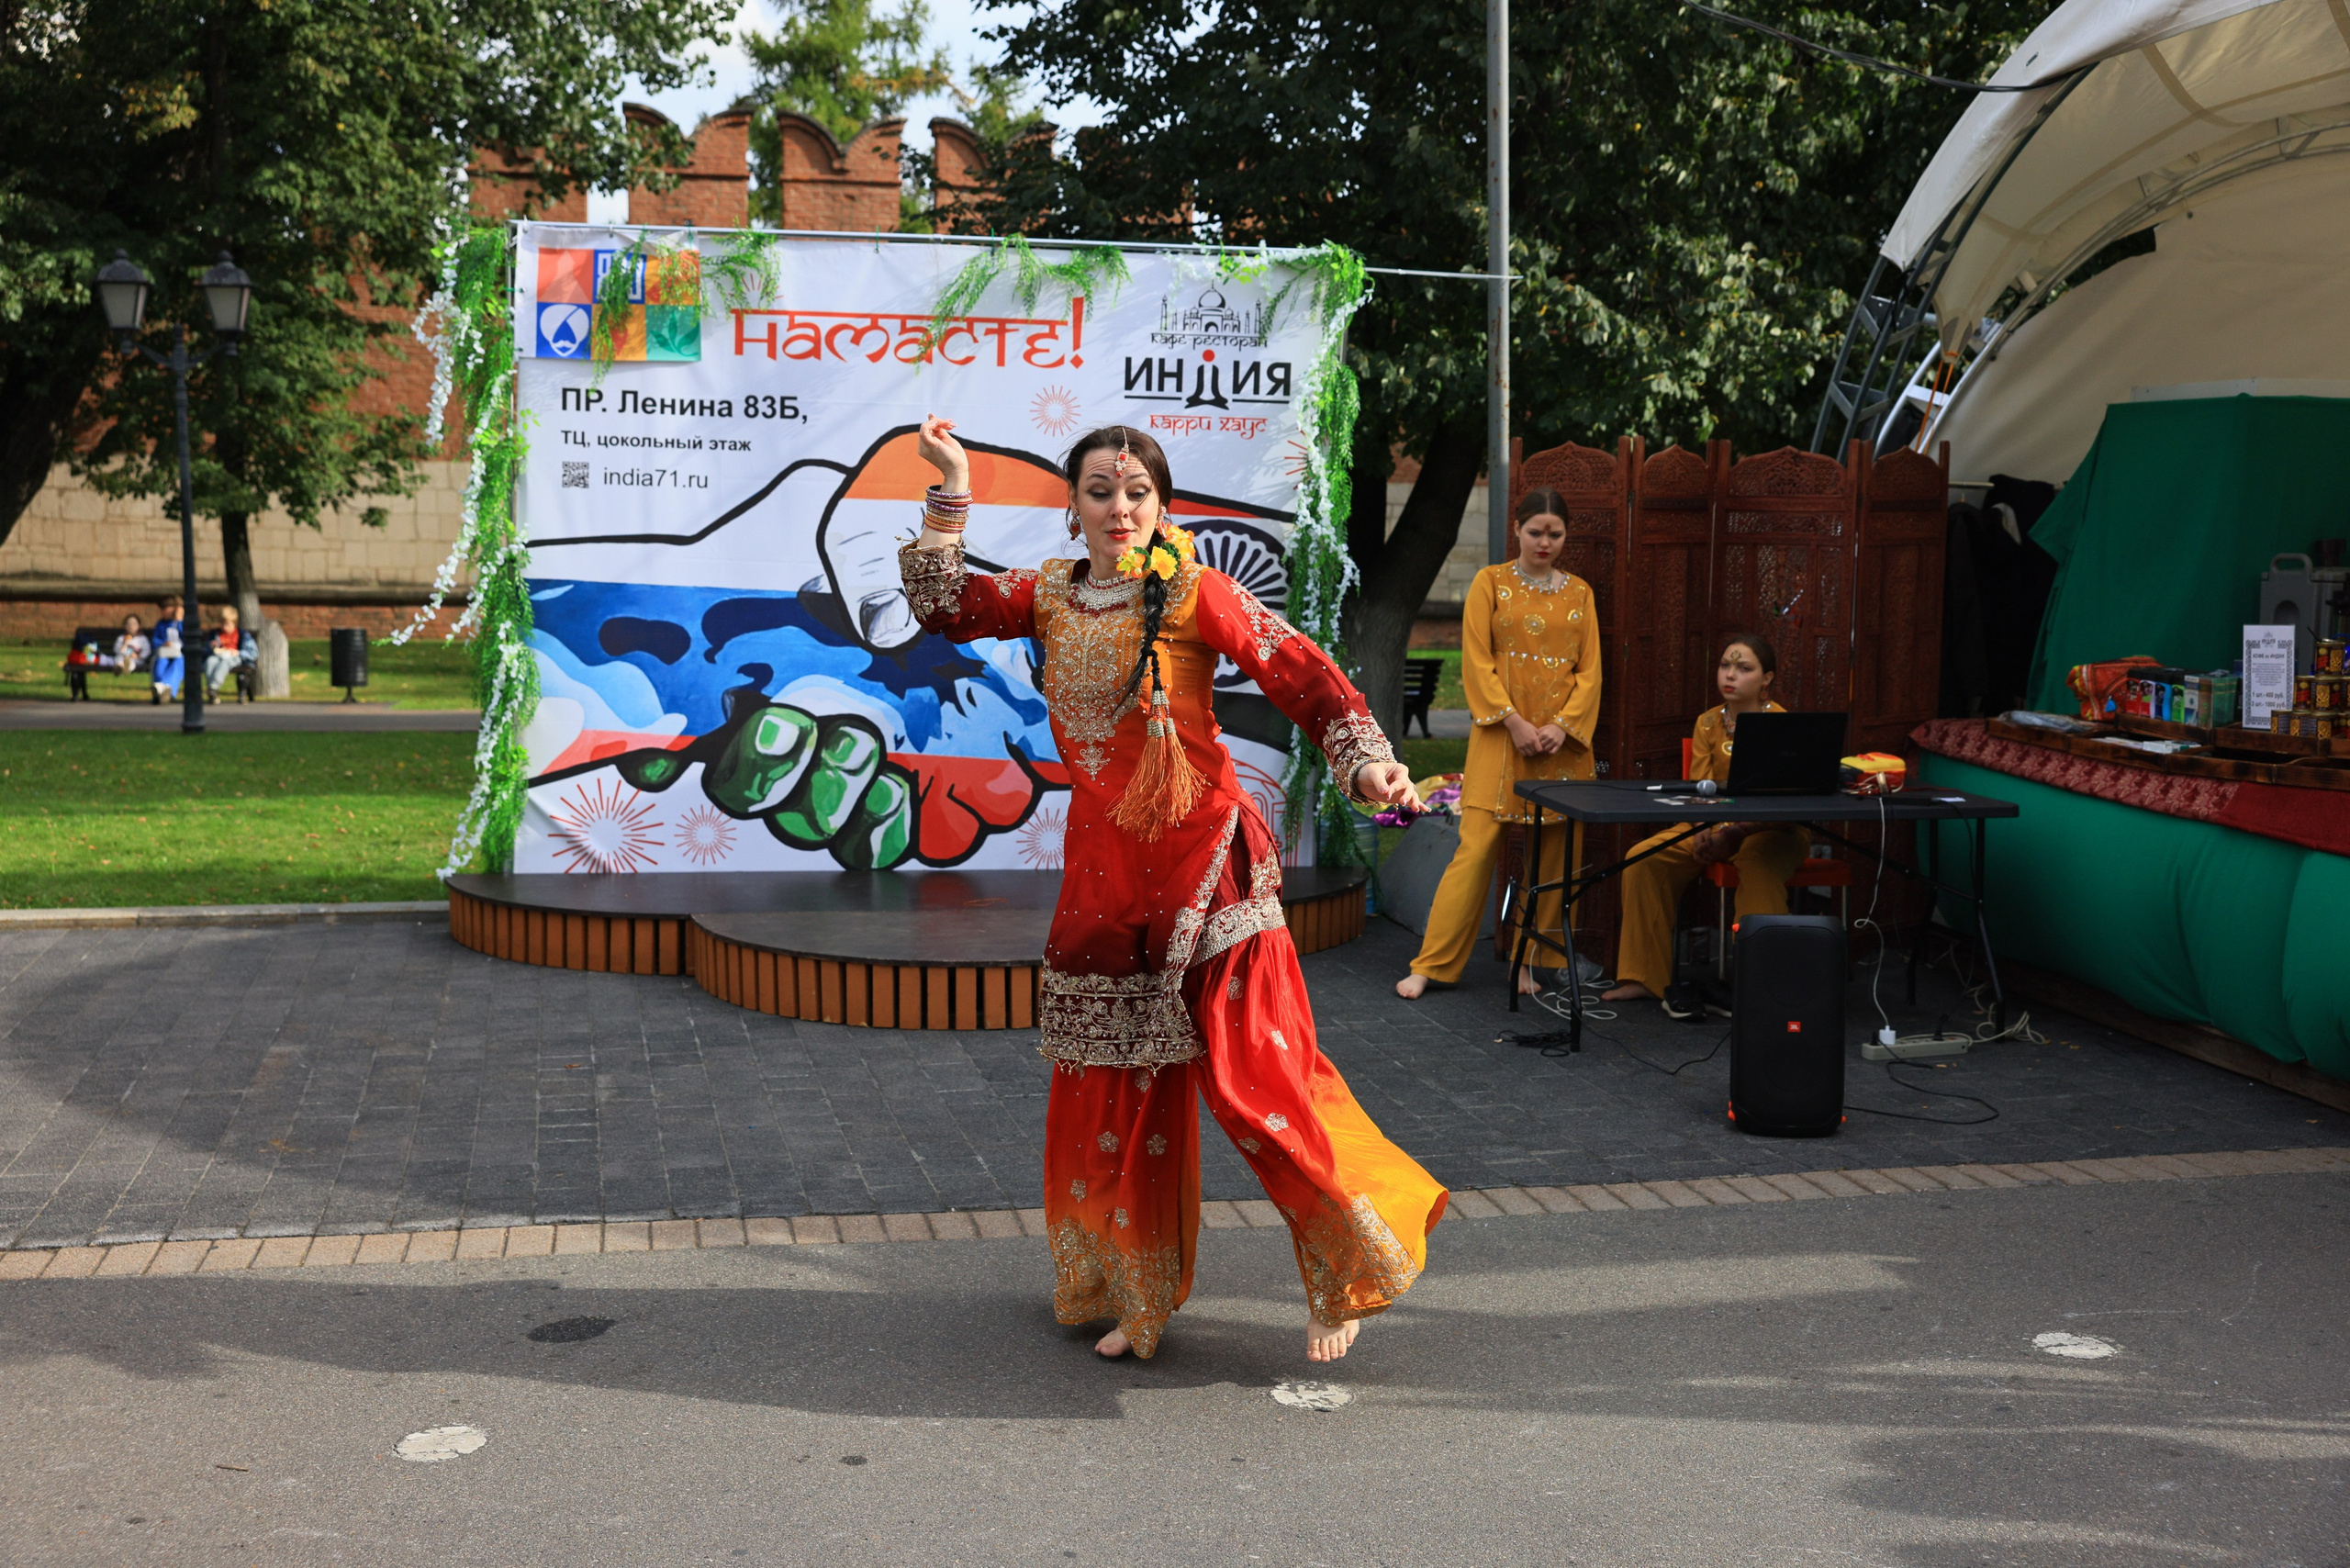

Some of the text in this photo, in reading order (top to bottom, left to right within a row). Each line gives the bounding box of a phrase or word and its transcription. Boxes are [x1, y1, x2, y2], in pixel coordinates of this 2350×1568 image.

[561, 387, 809, 424] ПР. Ленина 83Б,
[1219, 416, 1268, 440] хаус
[561, 431, 752, 452] ТЦ, цокольный этаж
[603, 467, 709, 489] india71.ru
